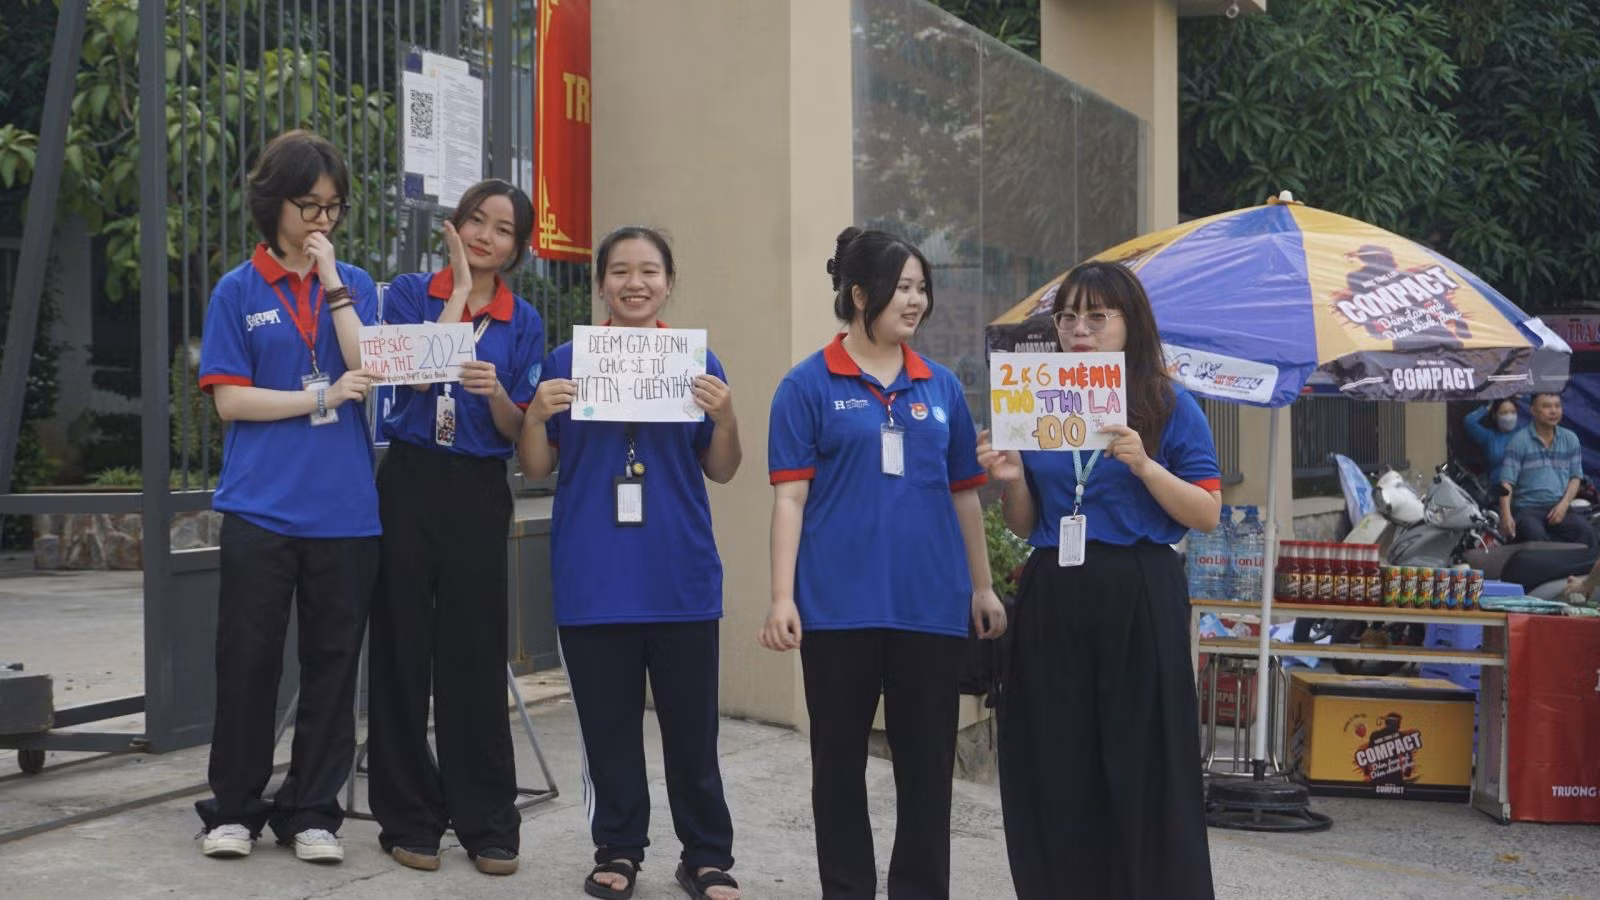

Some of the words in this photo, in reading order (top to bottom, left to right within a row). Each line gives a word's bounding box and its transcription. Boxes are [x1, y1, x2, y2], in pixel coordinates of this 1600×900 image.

[1338, 265, 1459, 324] COMPACT
[419, 332, 473, 370] 2024
[626, 334, 651, 353] GIA
[391, 354, 415, 371] THI
[599, 354, 628, 374] CHÚC
[1058, 362, 1122, 390] MỆNH
[1392, 367, 1475, 391] COMPACT
[592, 376, 620, 403] TIN
[1356, 733, 1421, 767] COMPACT
[1375, 785, 1404, 794] COMPACT
